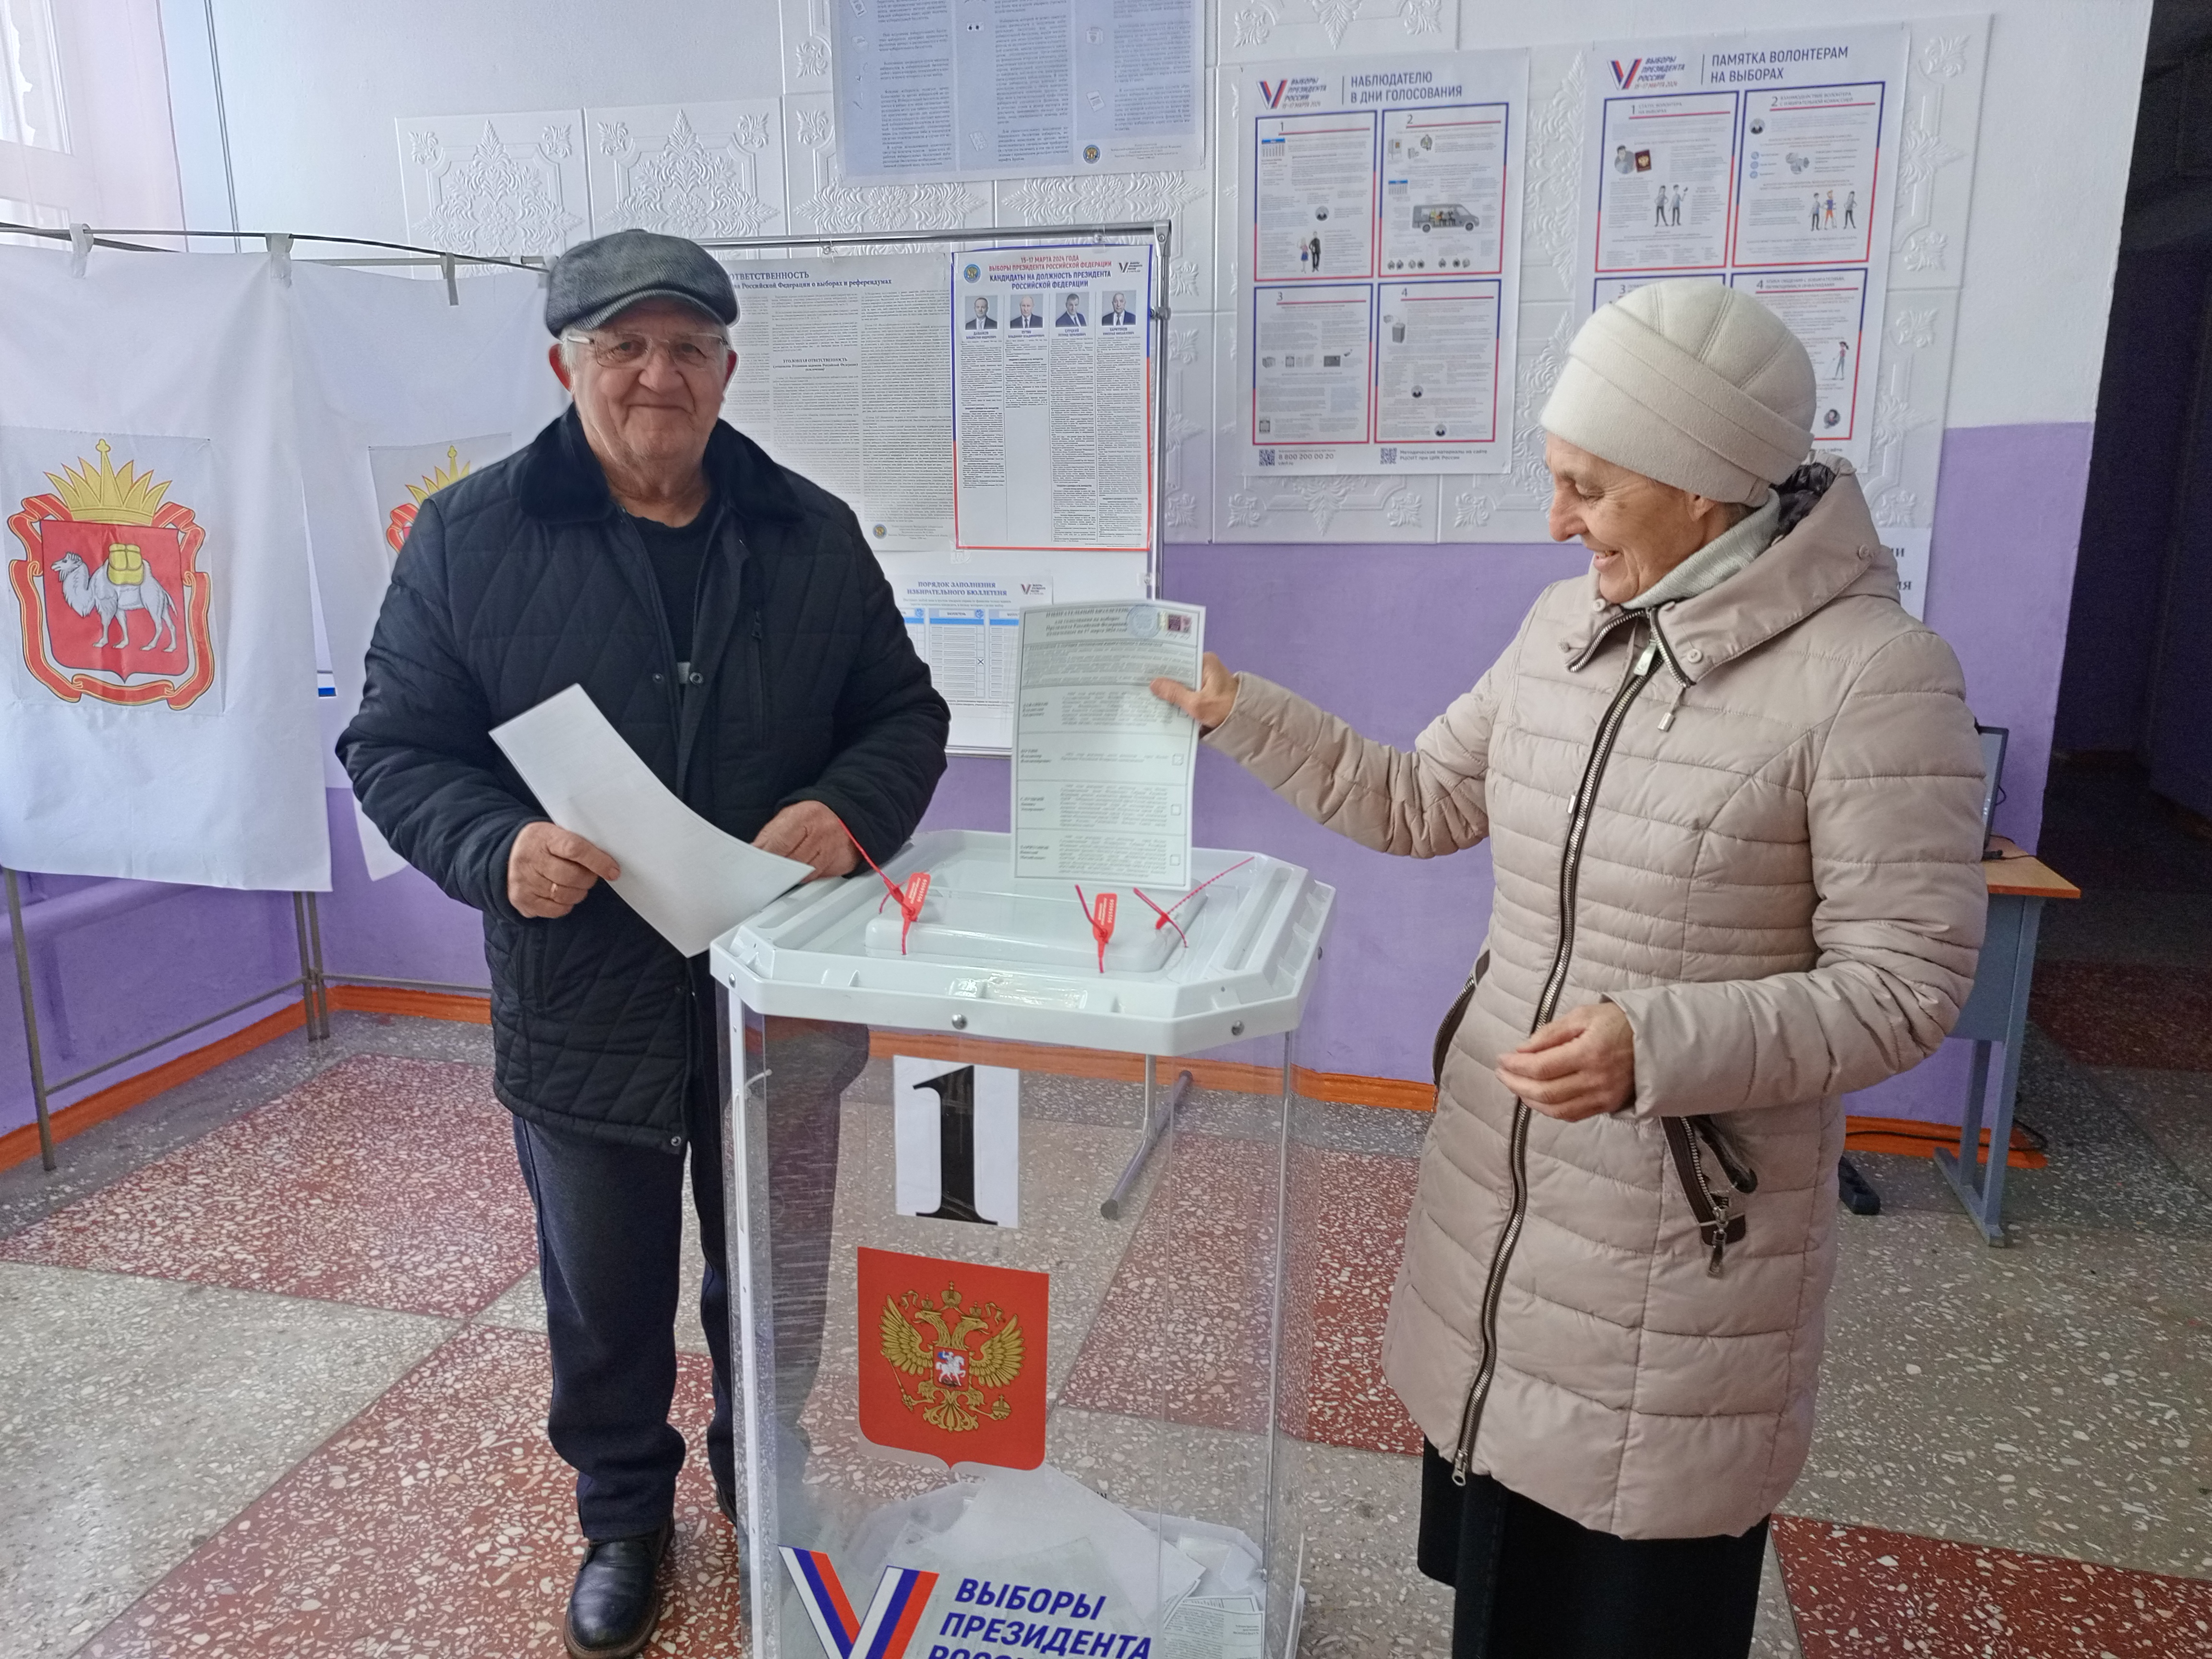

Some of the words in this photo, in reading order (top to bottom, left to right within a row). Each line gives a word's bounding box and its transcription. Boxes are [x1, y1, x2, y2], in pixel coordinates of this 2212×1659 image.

[1645, 56, 1677, 64] ВЫБОРЫ
[1712, 52, 1766, 67] ПАМЯТКА
[1769, 46, 1848, 63] ВОЛОНТЕРАМ
[1641, 64, 1685, 73] ПРЕЗИДЕНТА
[1351, 72, 1432, 88] НАБЛЮДАТЕЛЮ
[1637, 74, 1666, 82] РОССИИ
[1711, 71, 1725, 84] НА
[1729, 67, 1784, 83] ВЫБОРАХ
[1291, 77, 1319, 85] ВЫБОРЫ
[1287, 84, 1327, 94] ПРЕЗИДЕНТА
[1351, 92, 1357, 103] В
[1360, 90, 1382, 104] ДНИ
[1386, 85, 1462, 101] ГОЛОСОВАНИЯ
[1771, 96, 1778, 107] 2
[1632, 105, 1635, 115] 1
[1407, 114, 1413, 125] 2
[1281, 121, 1284, 132] 1
[989, 274, 1026, 282] КАНДИДАТЫ
[1036, 272, 1072, 281] ДОЛЖНОСТЬ
[1073, 270, 1111, 279] ПРЕЗИДЕНТА
[778, 281, 811, 289] Федерации
[849, 279, 892, 287] референдумах
[1012, 280, 1051, 290] РОССИЙСКОЙ
[1052, 280, 1088, 289] ФЕДЕРАЦИИ
[1756, 279, 1764, 289] 4
[1401, 288, 1407, 297] 4
[1619, 285, 1625, 294] 3
[1277, 292, 1283, 301] 3
[912, 1065, 998, 1226] 1
[955, 1578, 1106, 1620] ВЫБОРЫ
[939, 1611, 1152, 1659] ПРЕЗИДЕНТА
